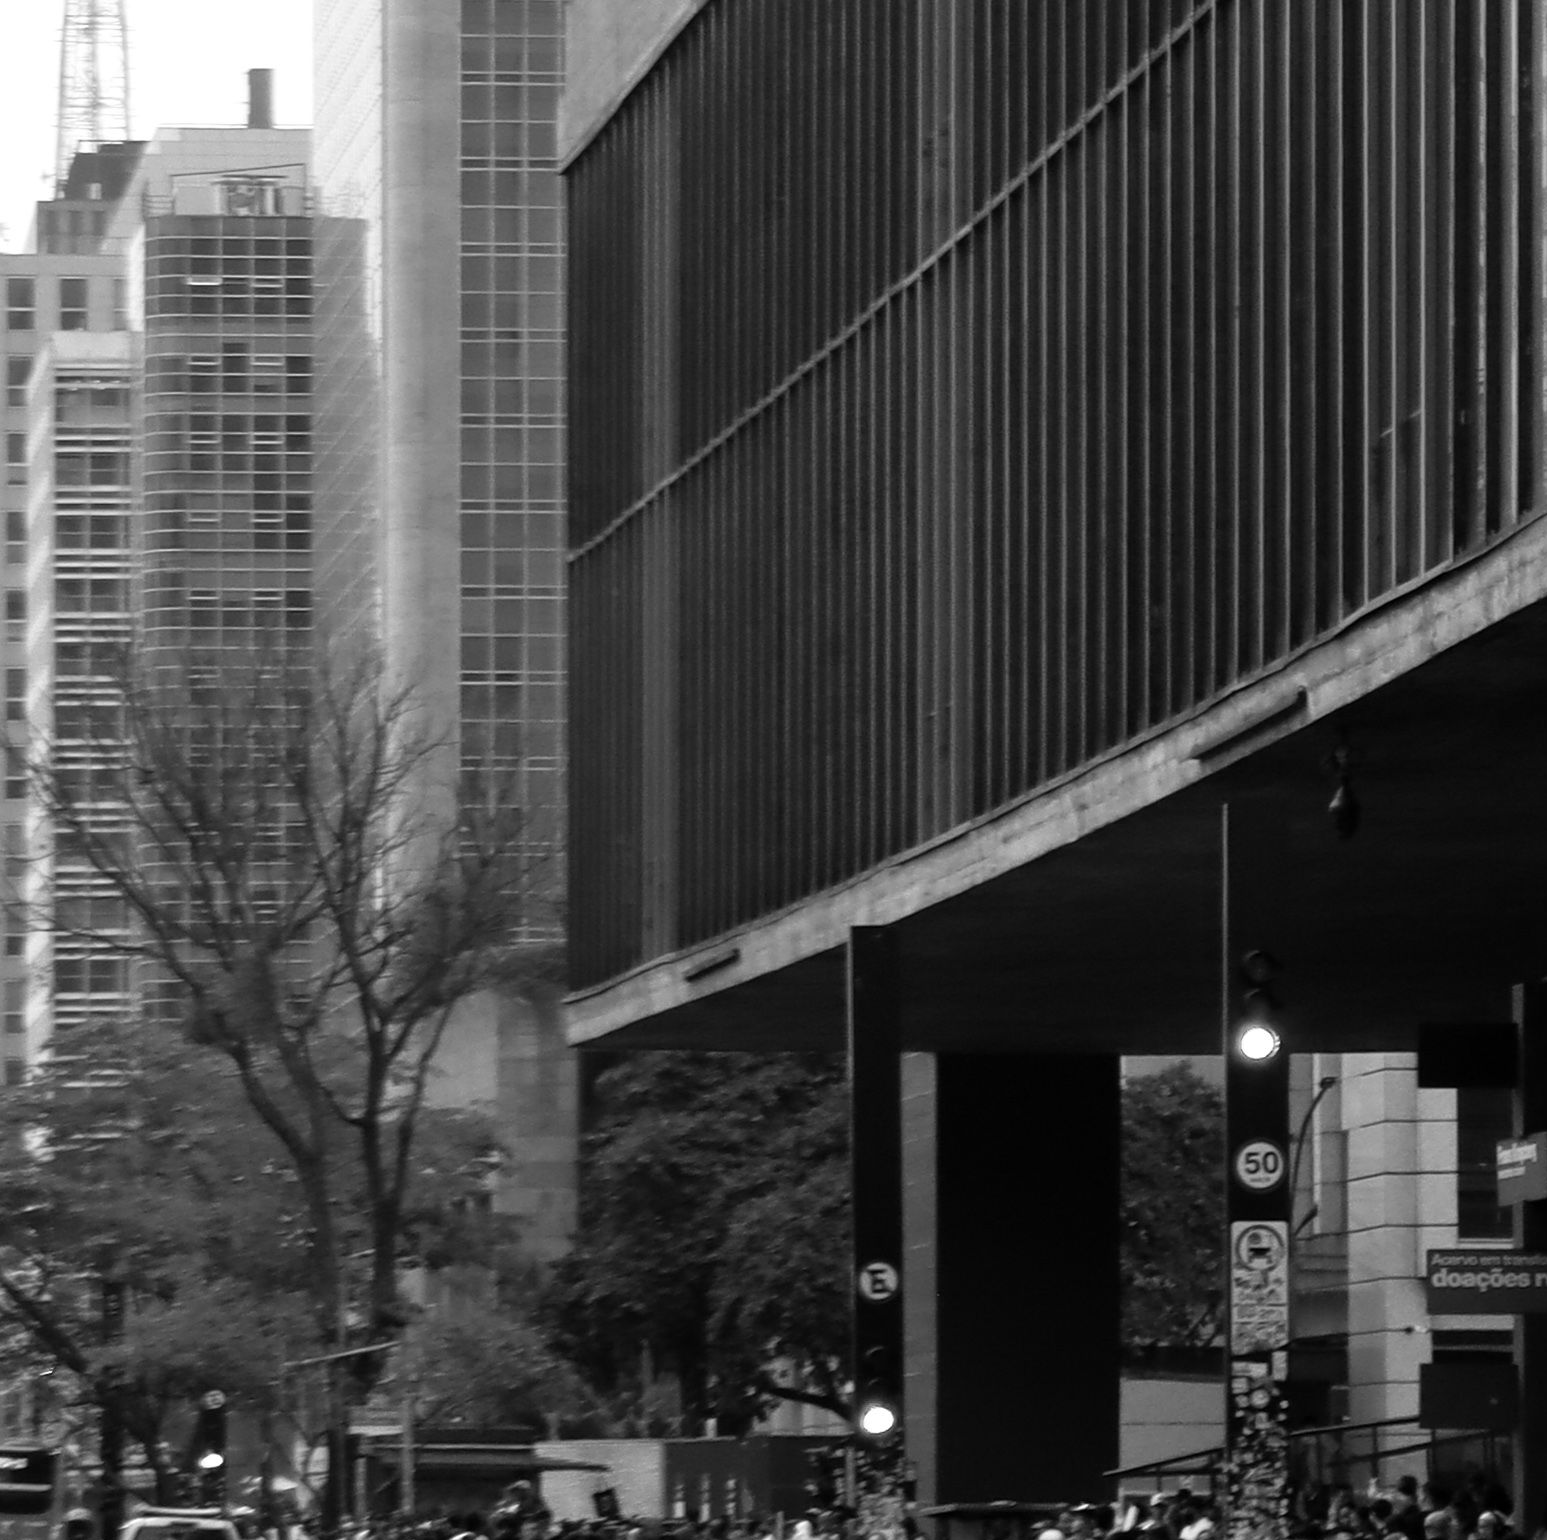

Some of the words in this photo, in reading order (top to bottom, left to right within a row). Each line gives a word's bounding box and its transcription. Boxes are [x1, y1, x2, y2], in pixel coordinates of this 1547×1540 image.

[1244, 1151, 1279, 1174] 50
[1431, 1253, 1478, 1266] Acervo
[1431, 1267, 1531, 1292] doações
